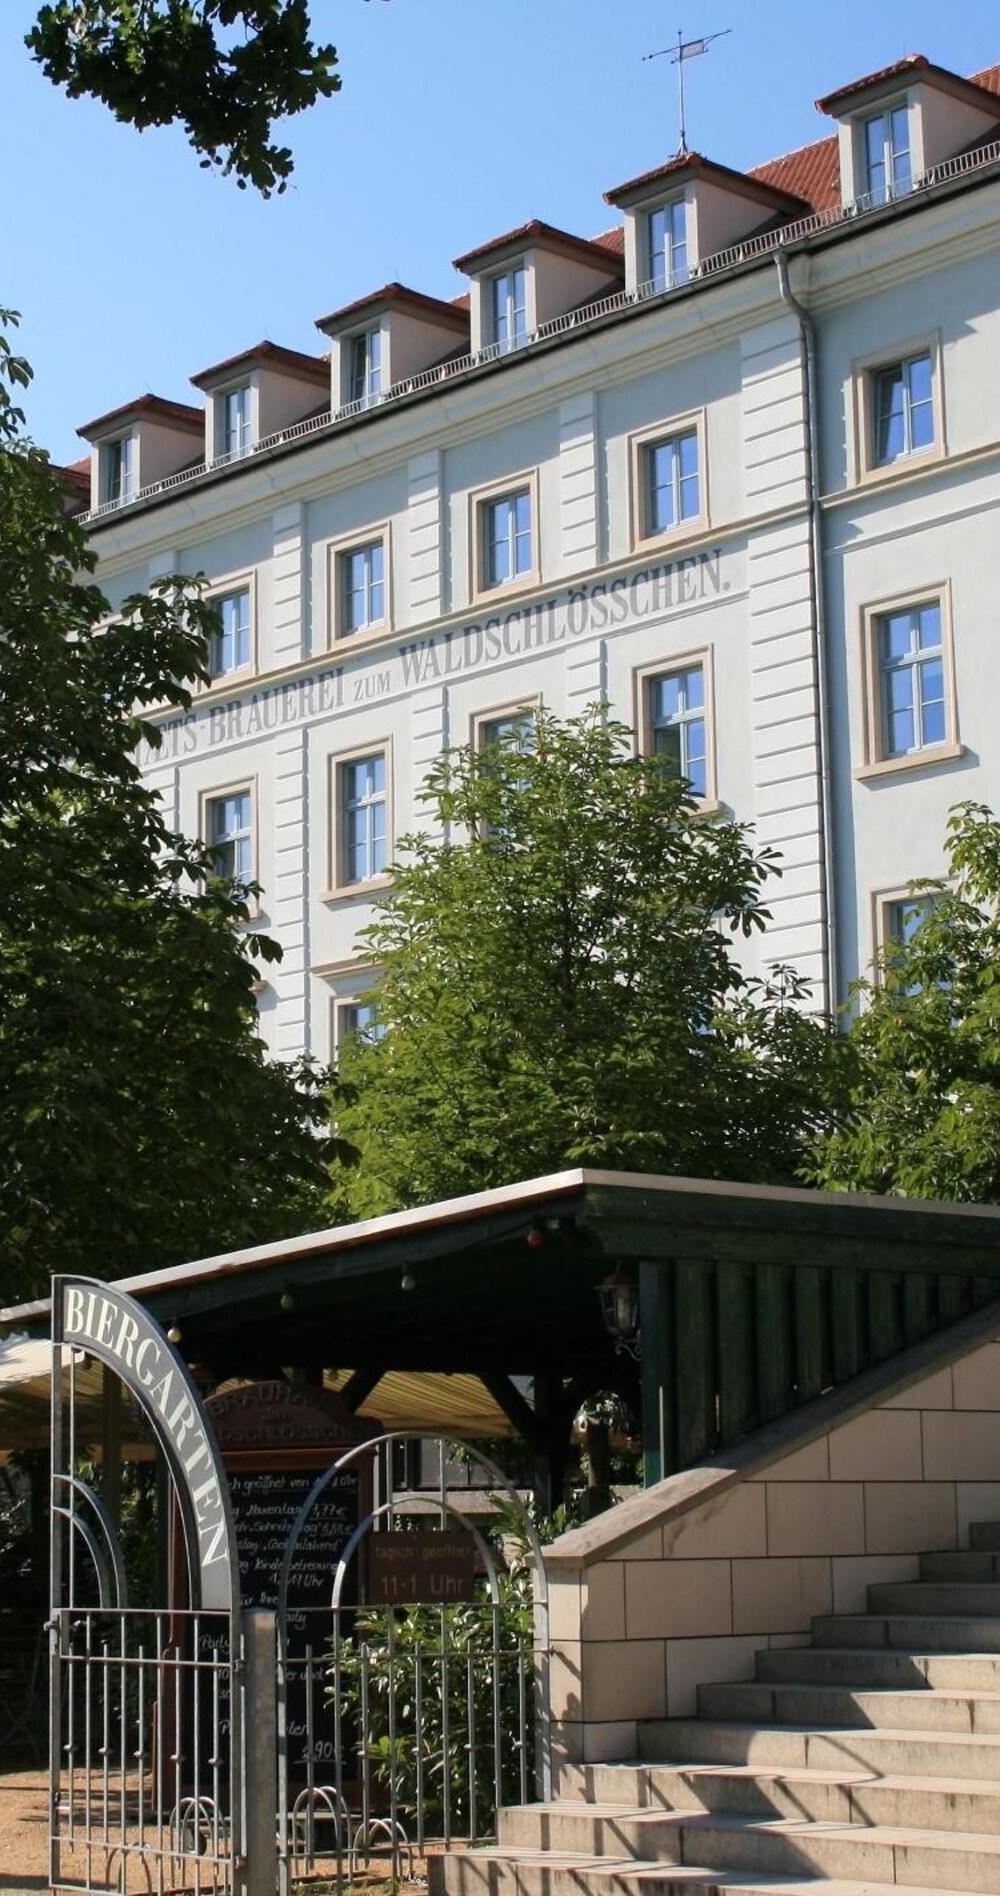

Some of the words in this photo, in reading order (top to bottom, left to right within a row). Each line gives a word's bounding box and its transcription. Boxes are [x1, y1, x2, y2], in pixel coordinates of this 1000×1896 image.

[353, 670, 392, 703] ZUM
[399, 548, 731, 686] WALDSCHLÖSSCHEN.
[65, 1288, 230, 1567] BIERGARTEN
[381, 1573, 417, 1596] 11-1
[429, 1573, 465, 1596] Uhr
